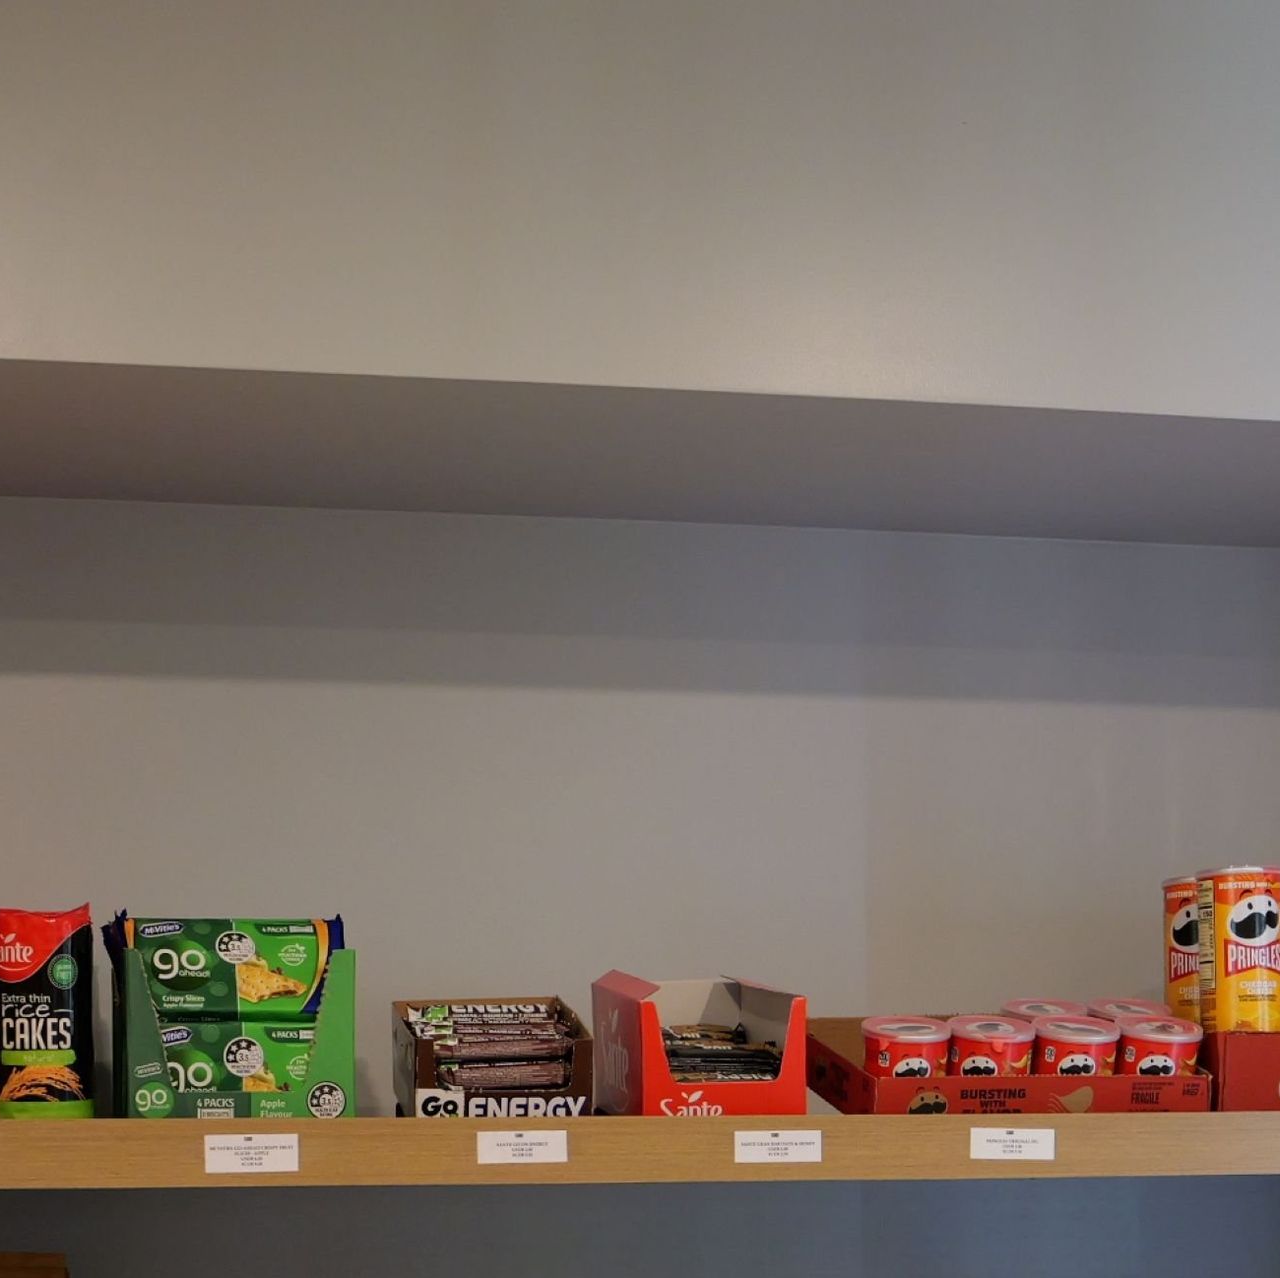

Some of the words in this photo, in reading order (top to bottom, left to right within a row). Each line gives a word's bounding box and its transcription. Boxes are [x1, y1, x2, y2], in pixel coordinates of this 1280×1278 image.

[153, 948, 206, 980] go
[1171, 950, 1199, 978] PRIN
[1227, 942, 1280, 973] PRINGLES
[1, 993, 26, 1003] Extra
[29, 993, 51, 1003] thin
[1, 1003, 51, 1018] rice
[2, 1017, 72, 1050] CAKES
[277, 1031, 298, 1039] PACKS
[960, 1088, 1026, 1100] BURSTING
[197, 1098, 203, 1107] 4
[204, 1098, 235, 1107] PACKS
[261, 1099, 286, 1109] Apple
[470, 1096, 587, 1117] ENERGY
[980, 1100, 1007, 1108] WITH
